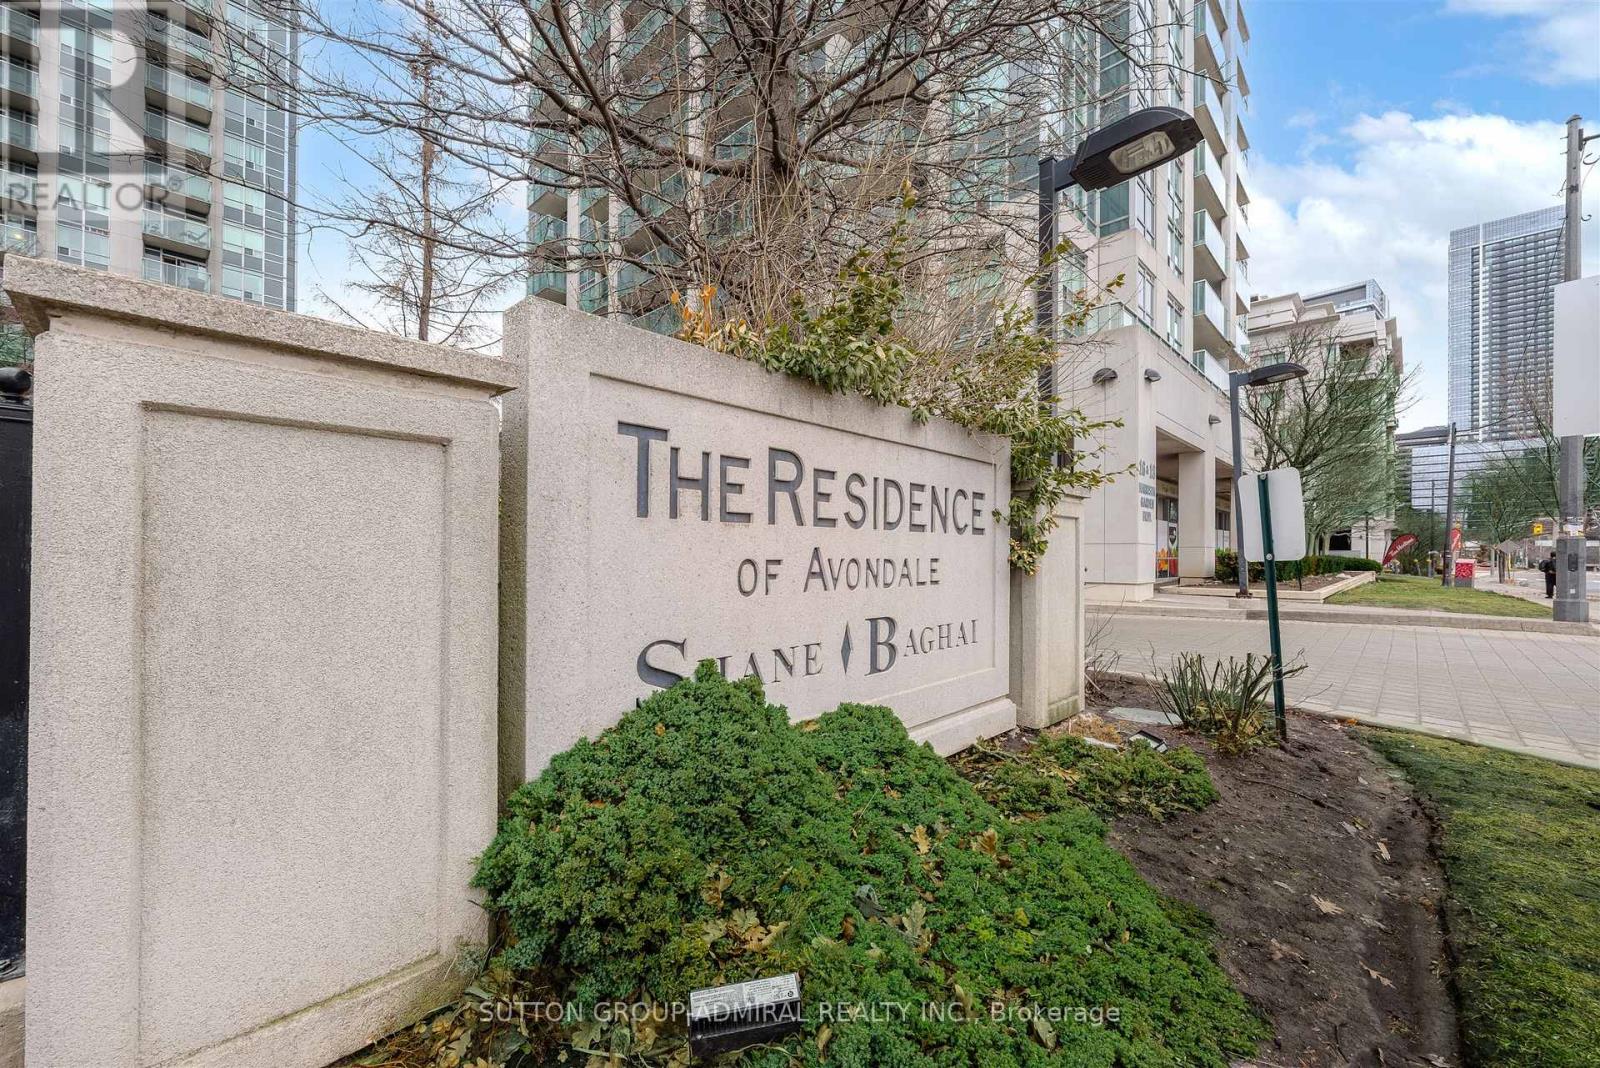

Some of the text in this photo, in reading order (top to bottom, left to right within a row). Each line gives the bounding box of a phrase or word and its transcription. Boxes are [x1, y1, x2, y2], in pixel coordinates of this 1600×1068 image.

[617, 420, 986, 535] THE RESIDENCE
[737, 546, 940, 597] OF AVONDALE
[636, 616, 979, 709] SANE BAGHAI
